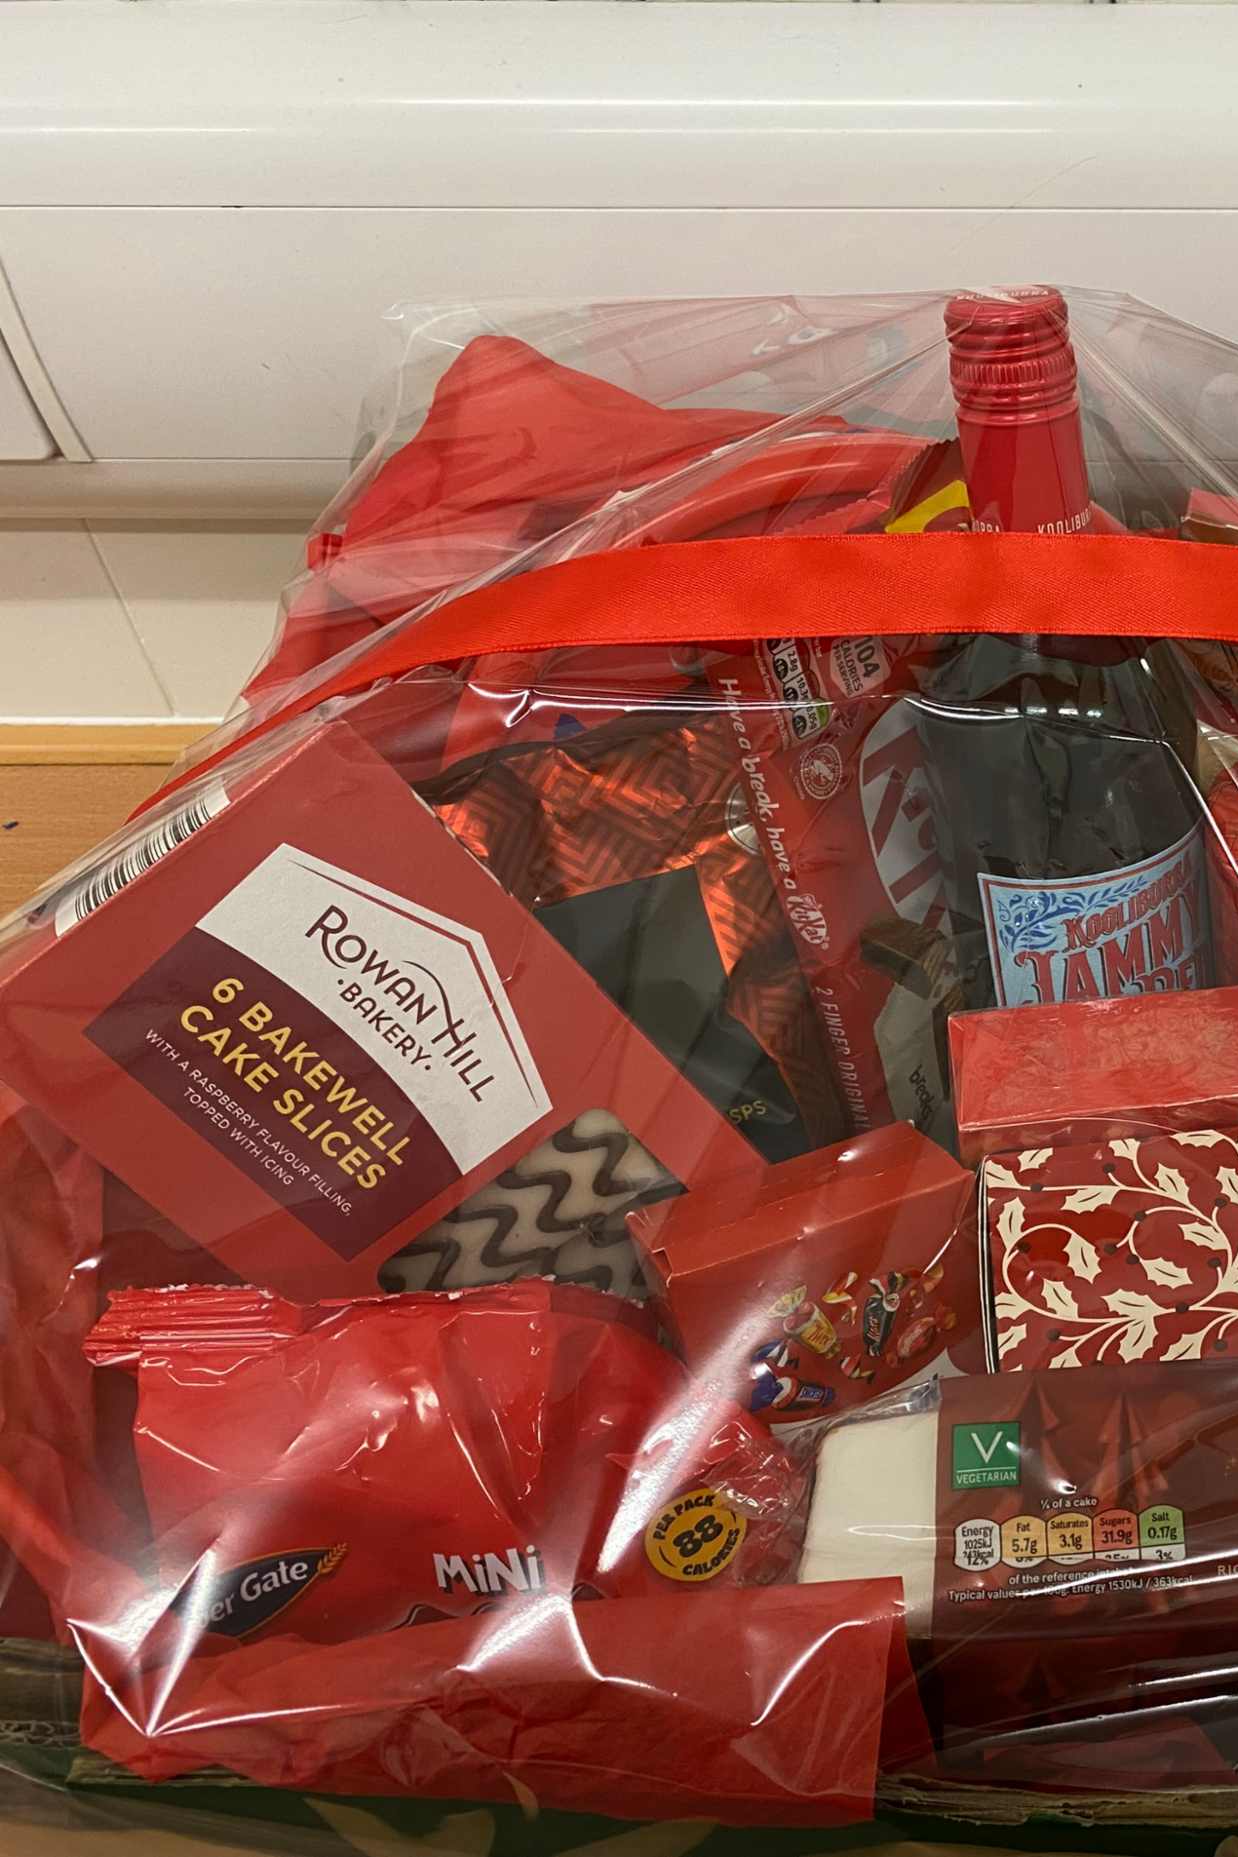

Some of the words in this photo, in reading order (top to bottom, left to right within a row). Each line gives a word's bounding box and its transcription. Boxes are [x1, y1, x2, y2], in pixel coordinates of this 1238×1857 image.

[840, 639, 864, 692] CALORIES
[854, 637, 881, 678] 104
[766, 826, 791, 873] have
[304, 904, 439, 1025] ROWAN
[415, 985, 495, 1102] HILL
[821, 1000, 850, 1057] FINGER
[212, 977, 244, 1004] 6
[239, 1001, 411, 1166] BAKEWELL
[145, 1027, 180, 1063] WITH
[178, 1056, 190, 1073] A
[188, 1065, 260, 1131] RASPBERRY
[255, 1124, 311, 1179] FLAVOUR
[180, 1004, 279, 1093] CAKE
[273, 1088, 387, 1190] SLICES
[183, 1086, 231, 1131] TOPPED
[230, 1128, 264, 1160] WITH
[259, 1155, 295, 1186] ICING
[969, 1431, 1002, 1464] V
[956, 1470, 1017, 1485] VEGETARIAN
[652, 1513, 676, 1540] PER
[673, 1494, 717, 1516] PACK
[1052, 1499, 1063, 1508] of
[1151, 1512, 1170, 1522] Salt
[672, 1514, 724, 1558] 88
[961, 1526, 994, 1538] Energy
[1016, 1522, 1031, 1533] Fat
[1050, 1519, 1089, 1530] Saturates
[1099, 1517, 1132, 1527] Sugars
[1101, 1529, 1133, 1545] 31.9g
[1147, 1526, 1178, 1541] 0.17g
[682, 1528, 740, 1576] CALORIES
[1012, 1538, 1038, 1554] 5.7g
[1059, 1534, 1083, 1550] 3.1g
[240, 1558, 309, 1604] Gate
[949, 1589, 985, 1602] Typical
[1072, 1582, 1105, 1596] Energy
[1108, 1579, 1144, 1592] 1530kJ
[1153, 1575, 1193, 1588] 363kcal
[1009, 1575, 1019, 1585] of
[1022, 1574, 1039, 1584] the
[1042, 1570, 1095, 1583] reference
